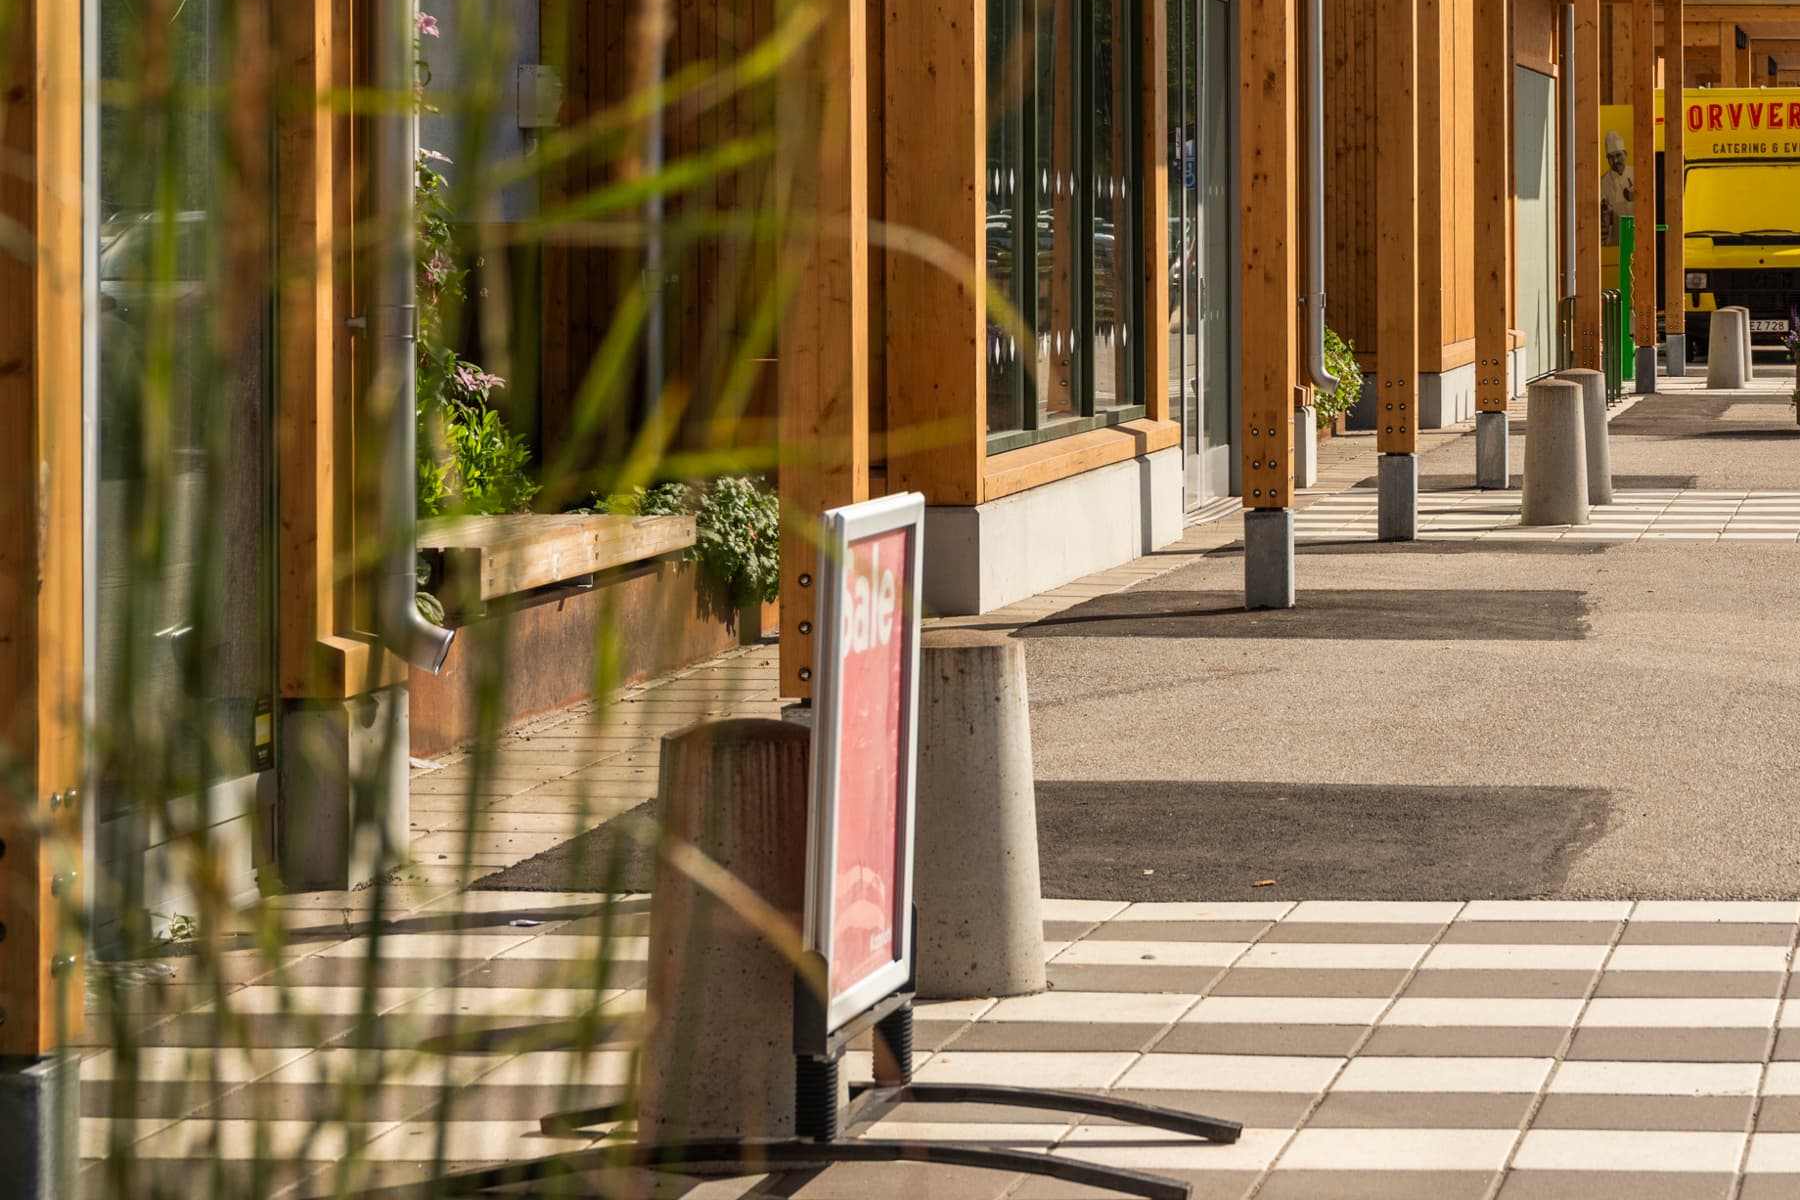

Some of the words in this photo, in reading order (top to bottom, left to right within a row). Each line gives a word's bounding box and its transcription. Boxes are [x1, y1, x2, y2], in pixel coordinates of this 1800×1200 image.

[1712, 142, 1766, 154] CATERING
[1772, 142, 1779, 153] &
[1749, 321, 1762, 331] EZ
[1764, 321, 1784, 331] 728
